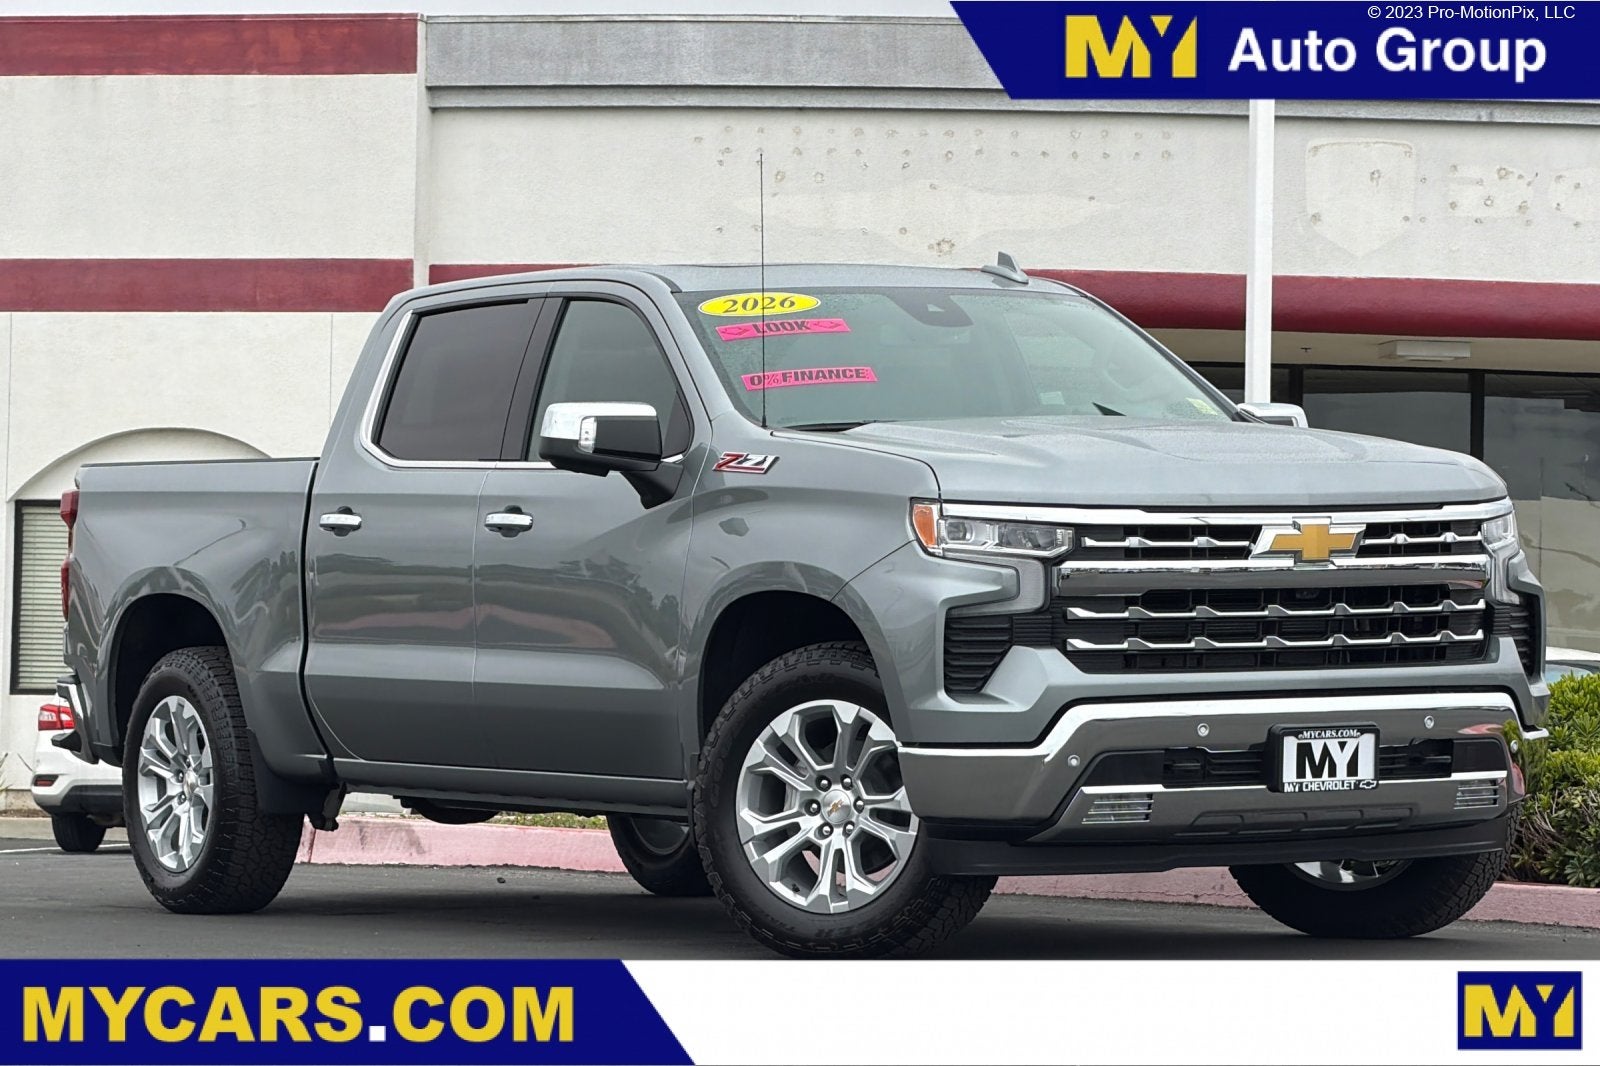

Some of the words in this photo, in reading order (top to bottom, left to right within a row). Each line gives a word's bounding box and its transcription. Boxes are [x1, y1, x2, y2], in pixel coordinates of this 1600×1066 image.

[722, 295, 797, 314] 2026
[752, 320, 811, 334] LOOK
[781, 367, 868, 383] FINANCE
[712, 452, 780, 475] Z71
[1296, 740, 1360, 780] MY
[1284, 782, 1299, 793] MY
[1302, 780, 1356, 792] CHEVROLET
